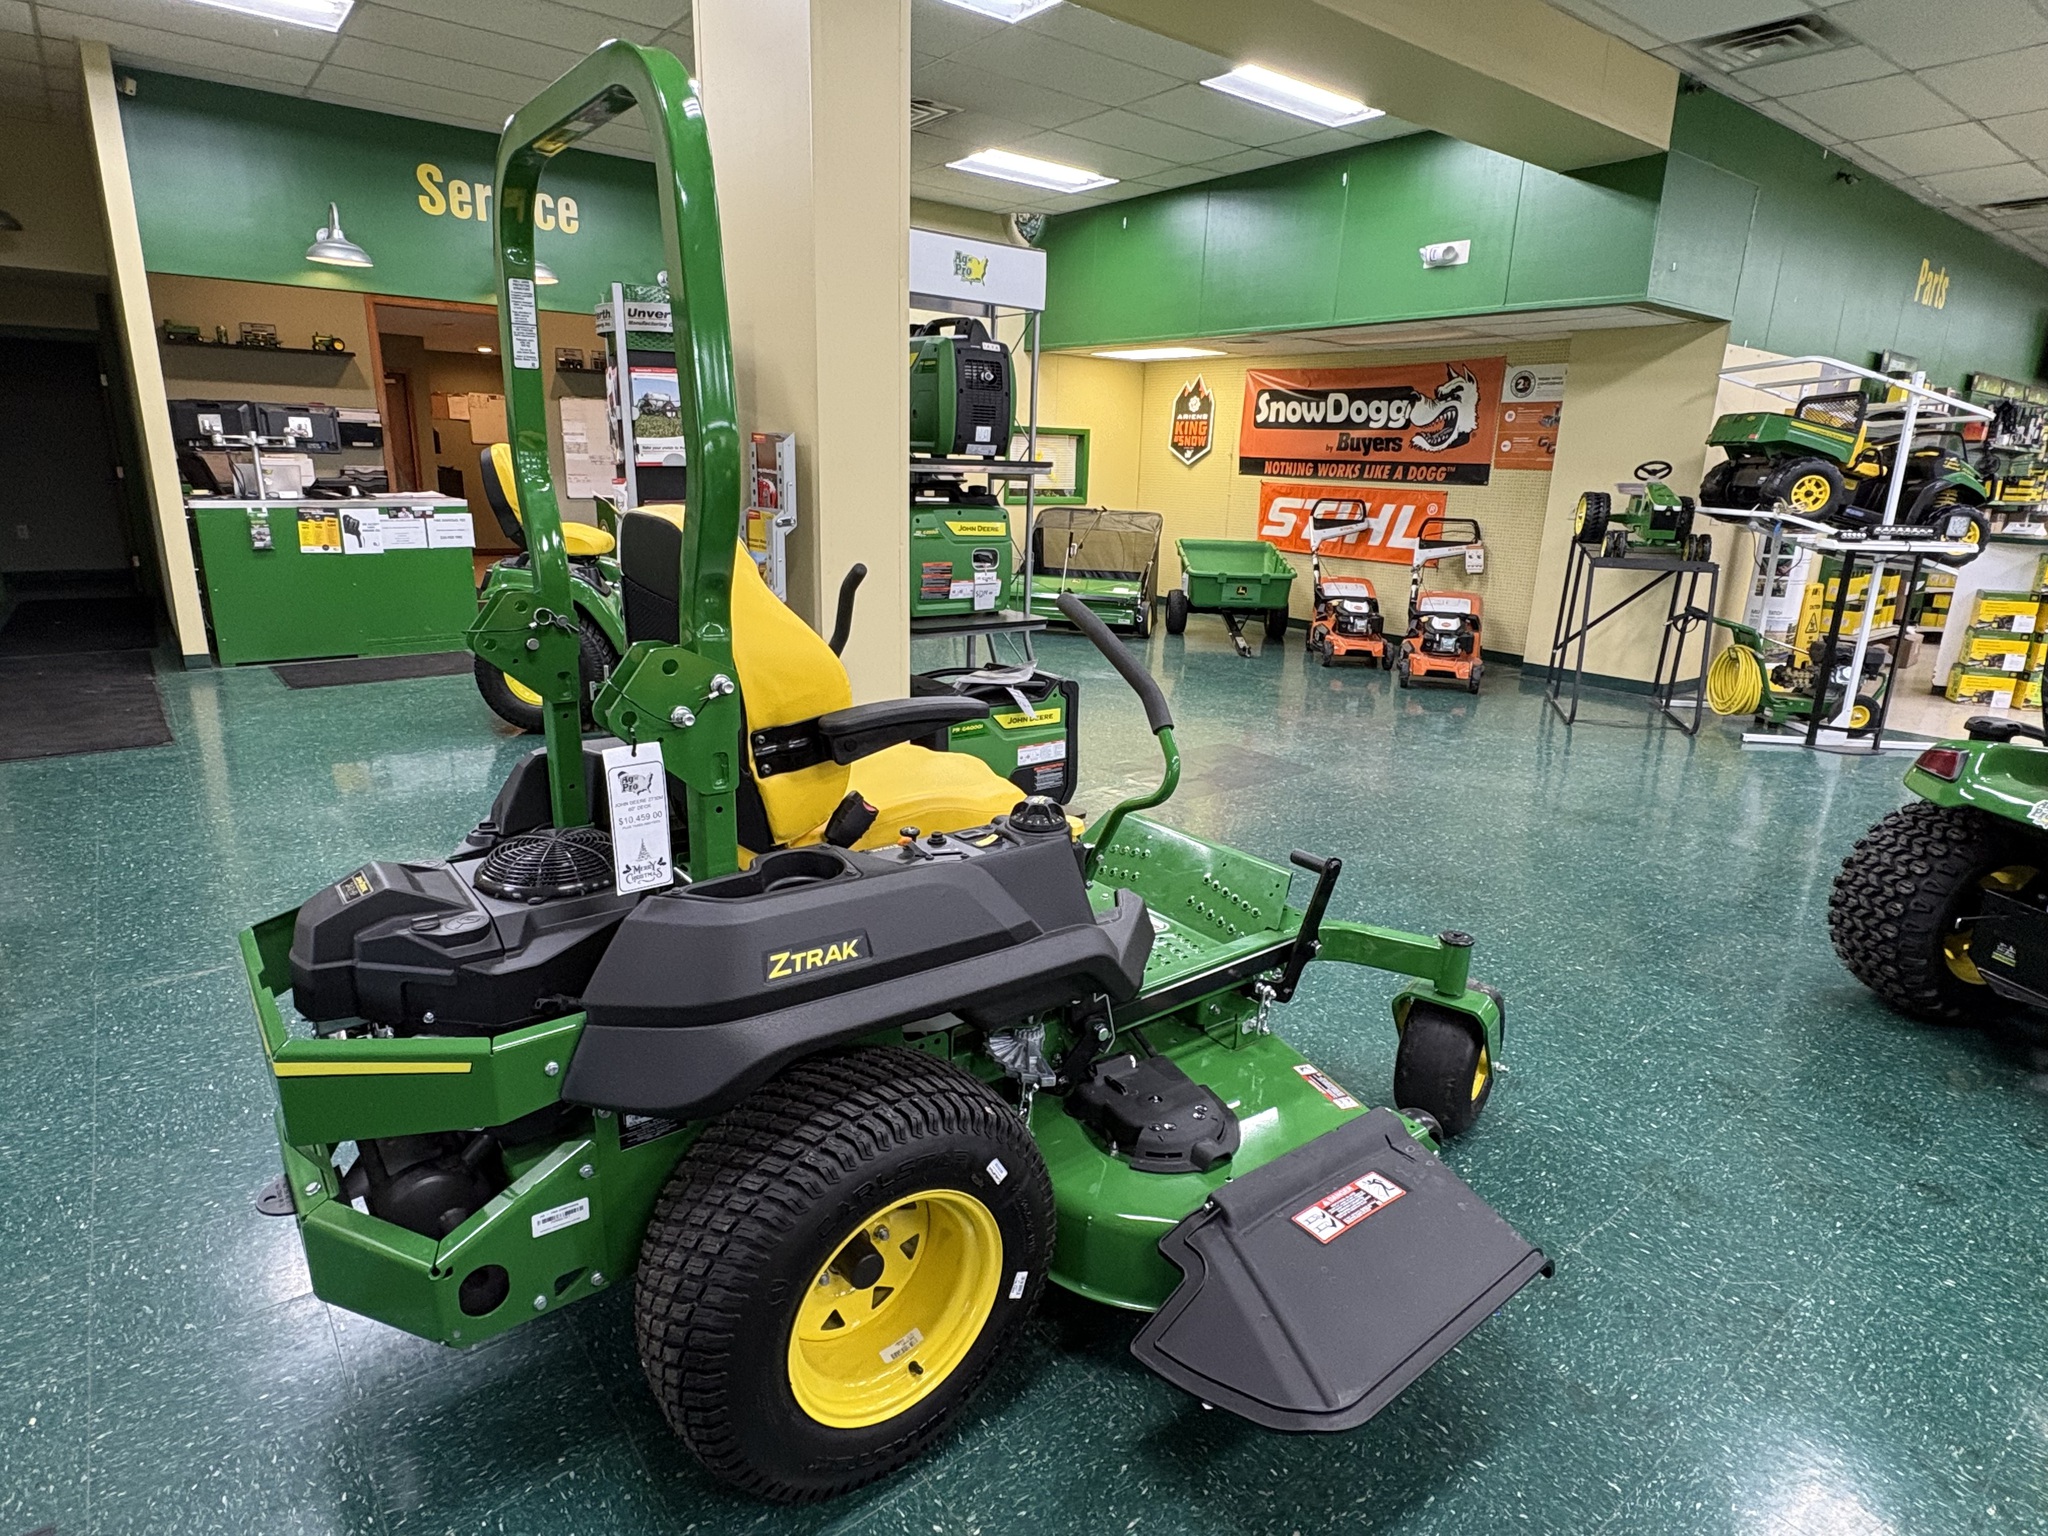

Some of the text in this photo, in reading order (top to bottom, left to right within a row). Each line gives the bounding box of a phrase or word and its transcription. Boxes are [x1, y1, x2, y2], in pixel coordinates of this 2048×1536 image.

[416, 163, 580, 235] Serce
[954, 263, 973, 278] Pro
[1914, 258, 1950, 310] Parts
[1256, 392, 1411, 429] SnowDogg
[1175, 421, 1208, 436] KING
[1178, 436, 1207, 447] SNOW
[1325, 433, 1403, 456] by Buyers
[1264, 461, 1314, 476] NOTHING
[1317, 462, 1360, 479] WORKS
[1362, 464, 1391, 480] LIKE
[1393, 465, 1404, 480] A
[1260, 496, 1420, 550] STIHL
[1008, 716, 1028, 725] JOHN
[621, 774, 634, 786] Ag
[621, 782, 639, 793] Pro
[614, 800, 629, 808] JOHN
[629, 797, 647, 806] DEERE
[631, 860, 658, 874] MERRY
[625, 868, 663, 884] CHRISTMAS
[768, 938, 859, 979] ZTRAK
